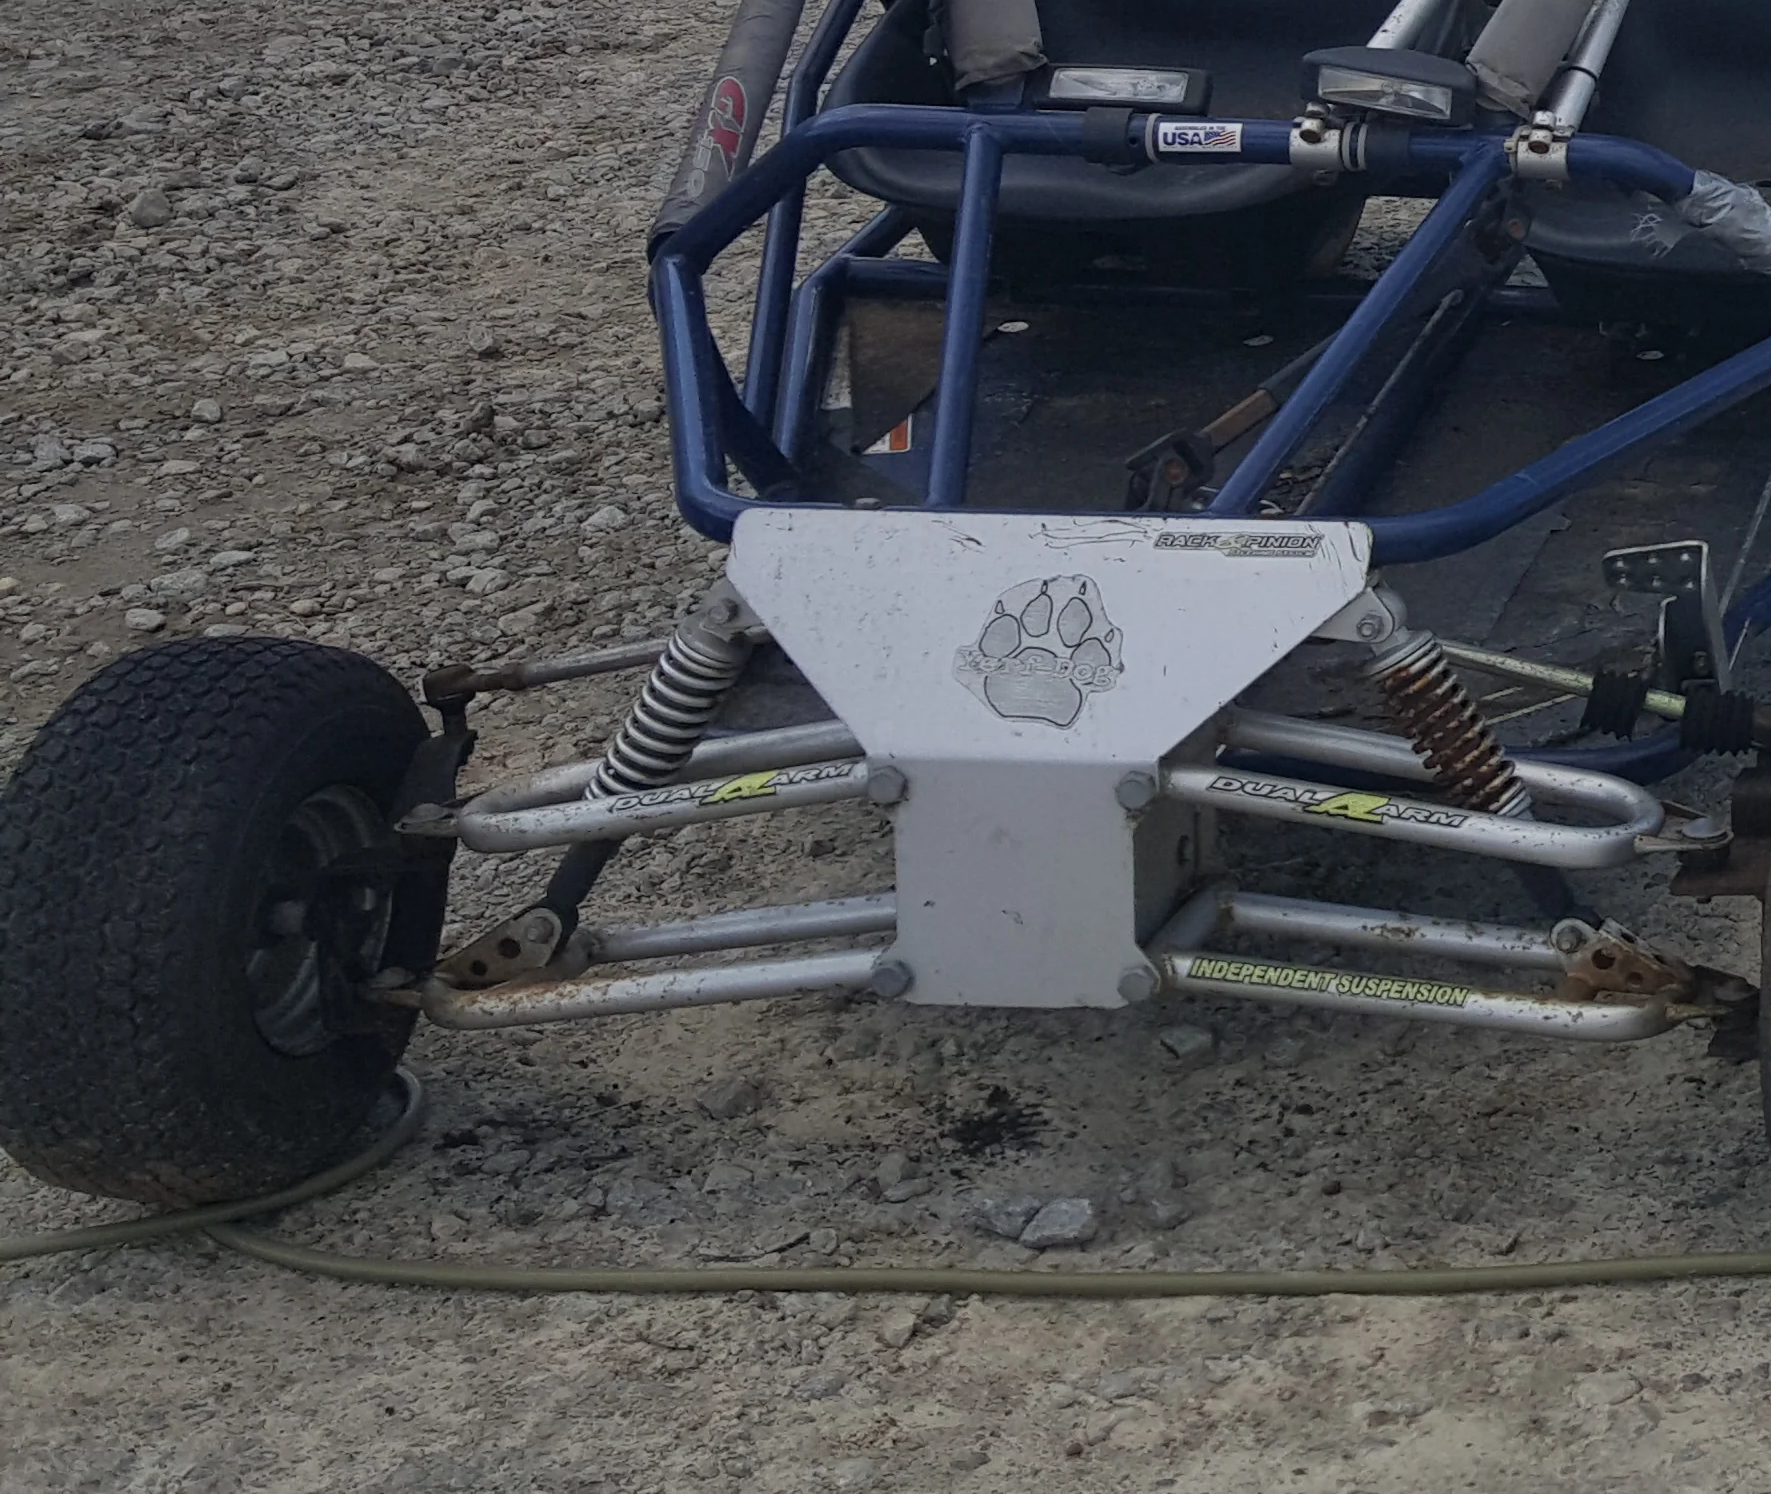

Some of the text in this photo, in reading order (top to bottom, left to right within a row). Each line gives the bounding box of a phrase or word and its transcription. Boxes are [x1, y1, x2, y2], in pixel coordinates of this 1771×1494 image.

[1162, 131, 1203, 146] USA
[1155, 533, 1221, 548] RACK
[1244, 535, 1324, 550] PINION
[764, 760, 853, 788] ARM
[1207, 776, 1335, 806] DUAL
[1371, 804, 1470, 828] ARM
[1188, 957, 1469, 1008] INDEPENDENT SUSPENSION
